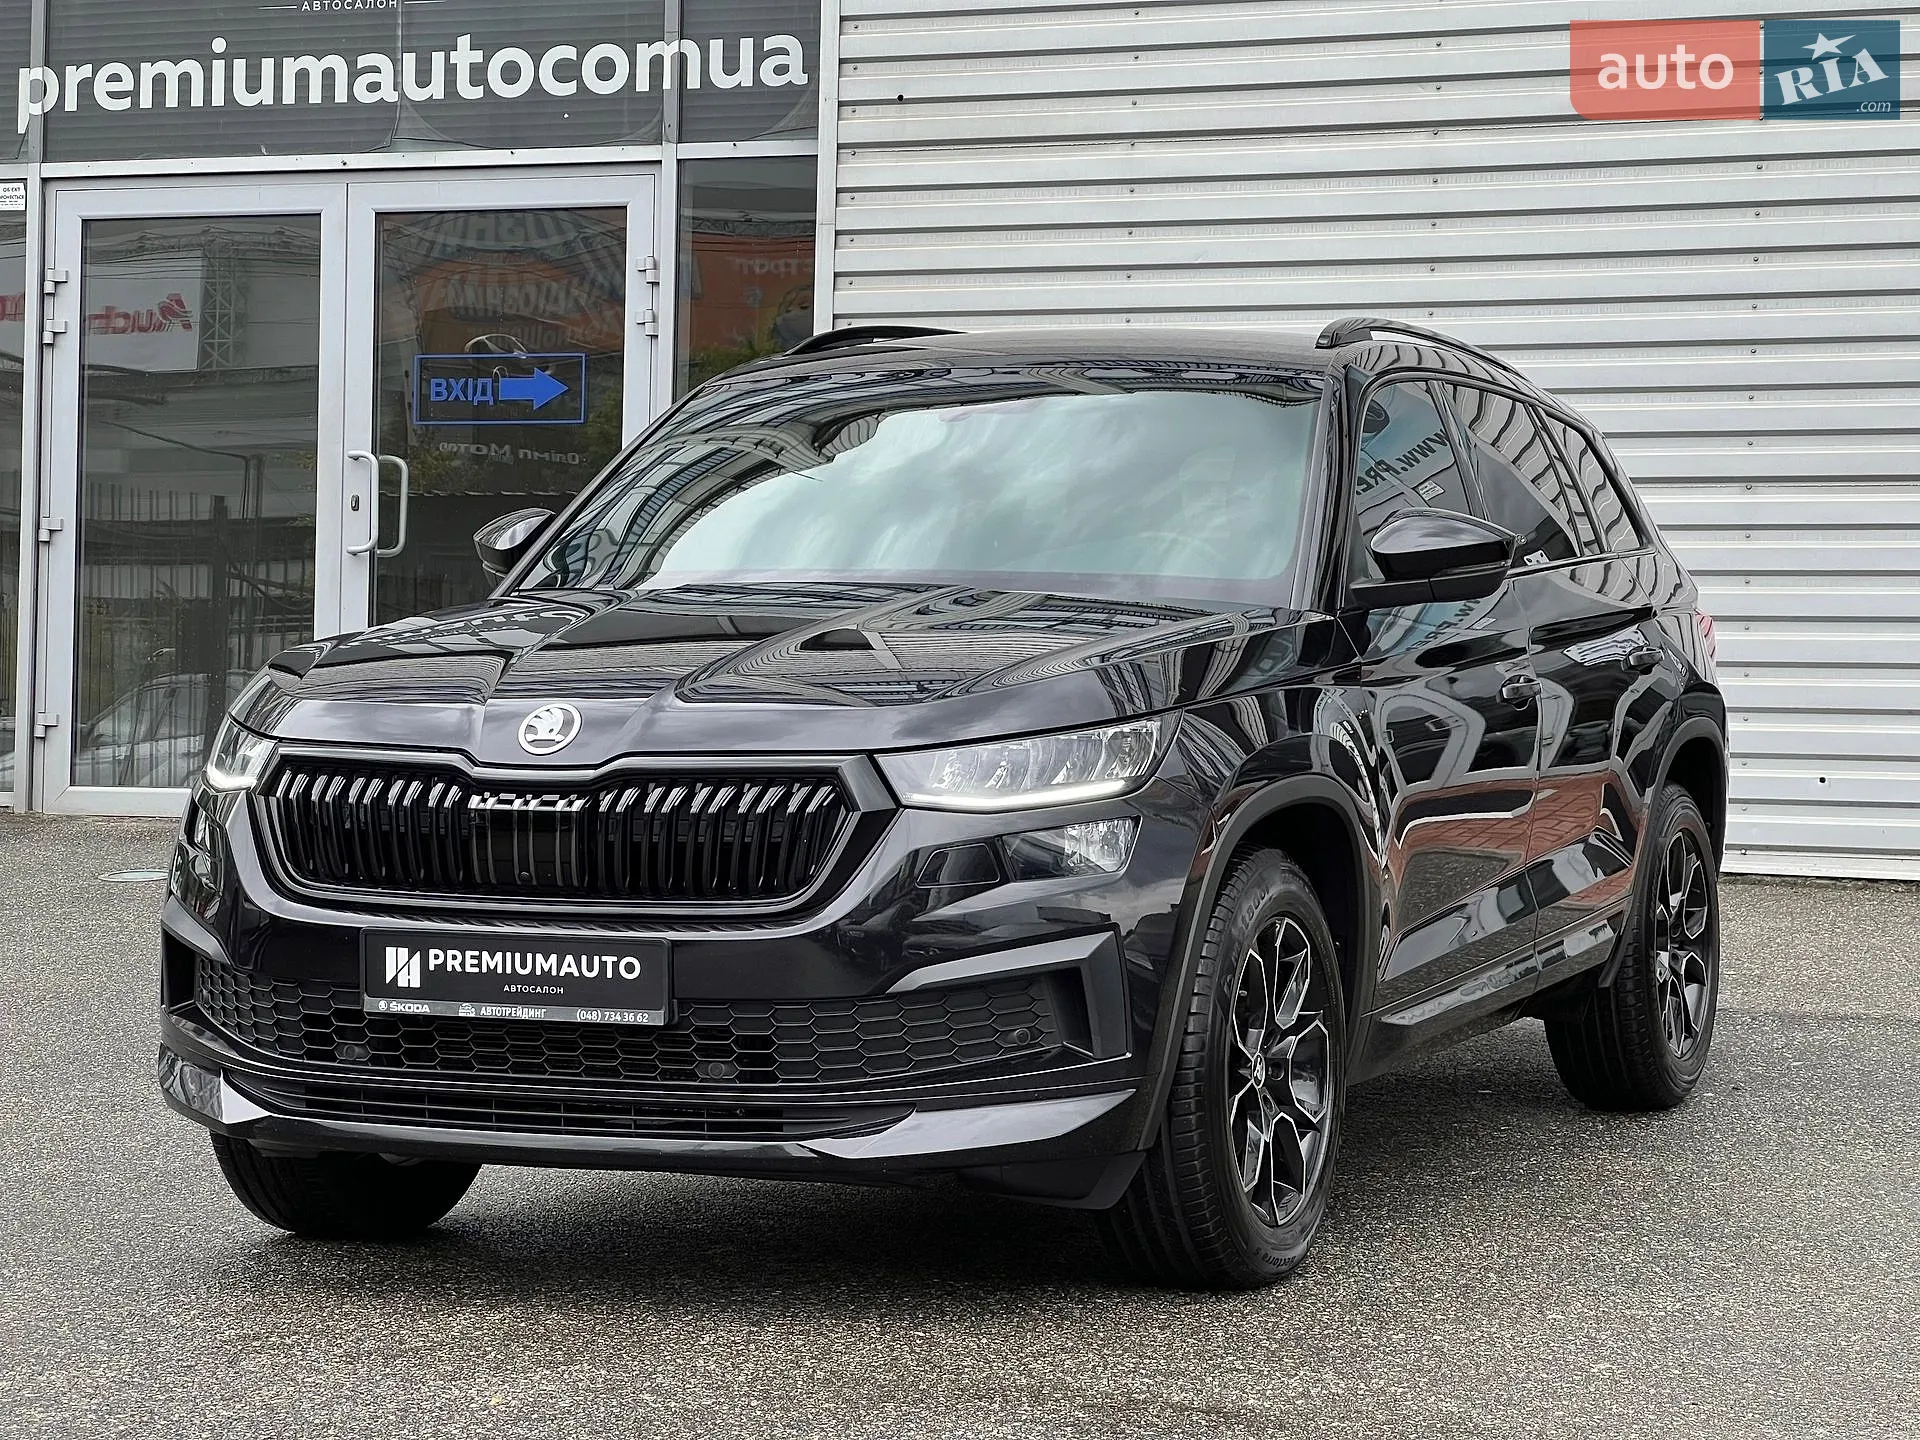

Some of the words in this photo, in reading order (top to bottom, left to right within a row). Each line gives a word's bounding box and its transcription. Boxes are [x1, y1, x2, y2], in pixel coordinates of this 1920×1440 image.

[301, 0, 398, 12] АВТОСАЛОН
[17, 34, 809, 134] premiumautocomua
[430, 378, 494, 405] ВХІД
[428, 948, 641, 980] PREMIUMAUTO
[503, 984, 564, 995] АВТОСАЛОН
[389, 1001, 430, 1014] ŠKODA
[480, 1006, 547, 1020] АВТОТРЕЙДИНГ
[576, 1008, 601, 1022] (048)
[604, 1011, 621, 1022] 734
[623, 1013, 635, 1022] 36
[636, 1012, 649, 1023] 62
